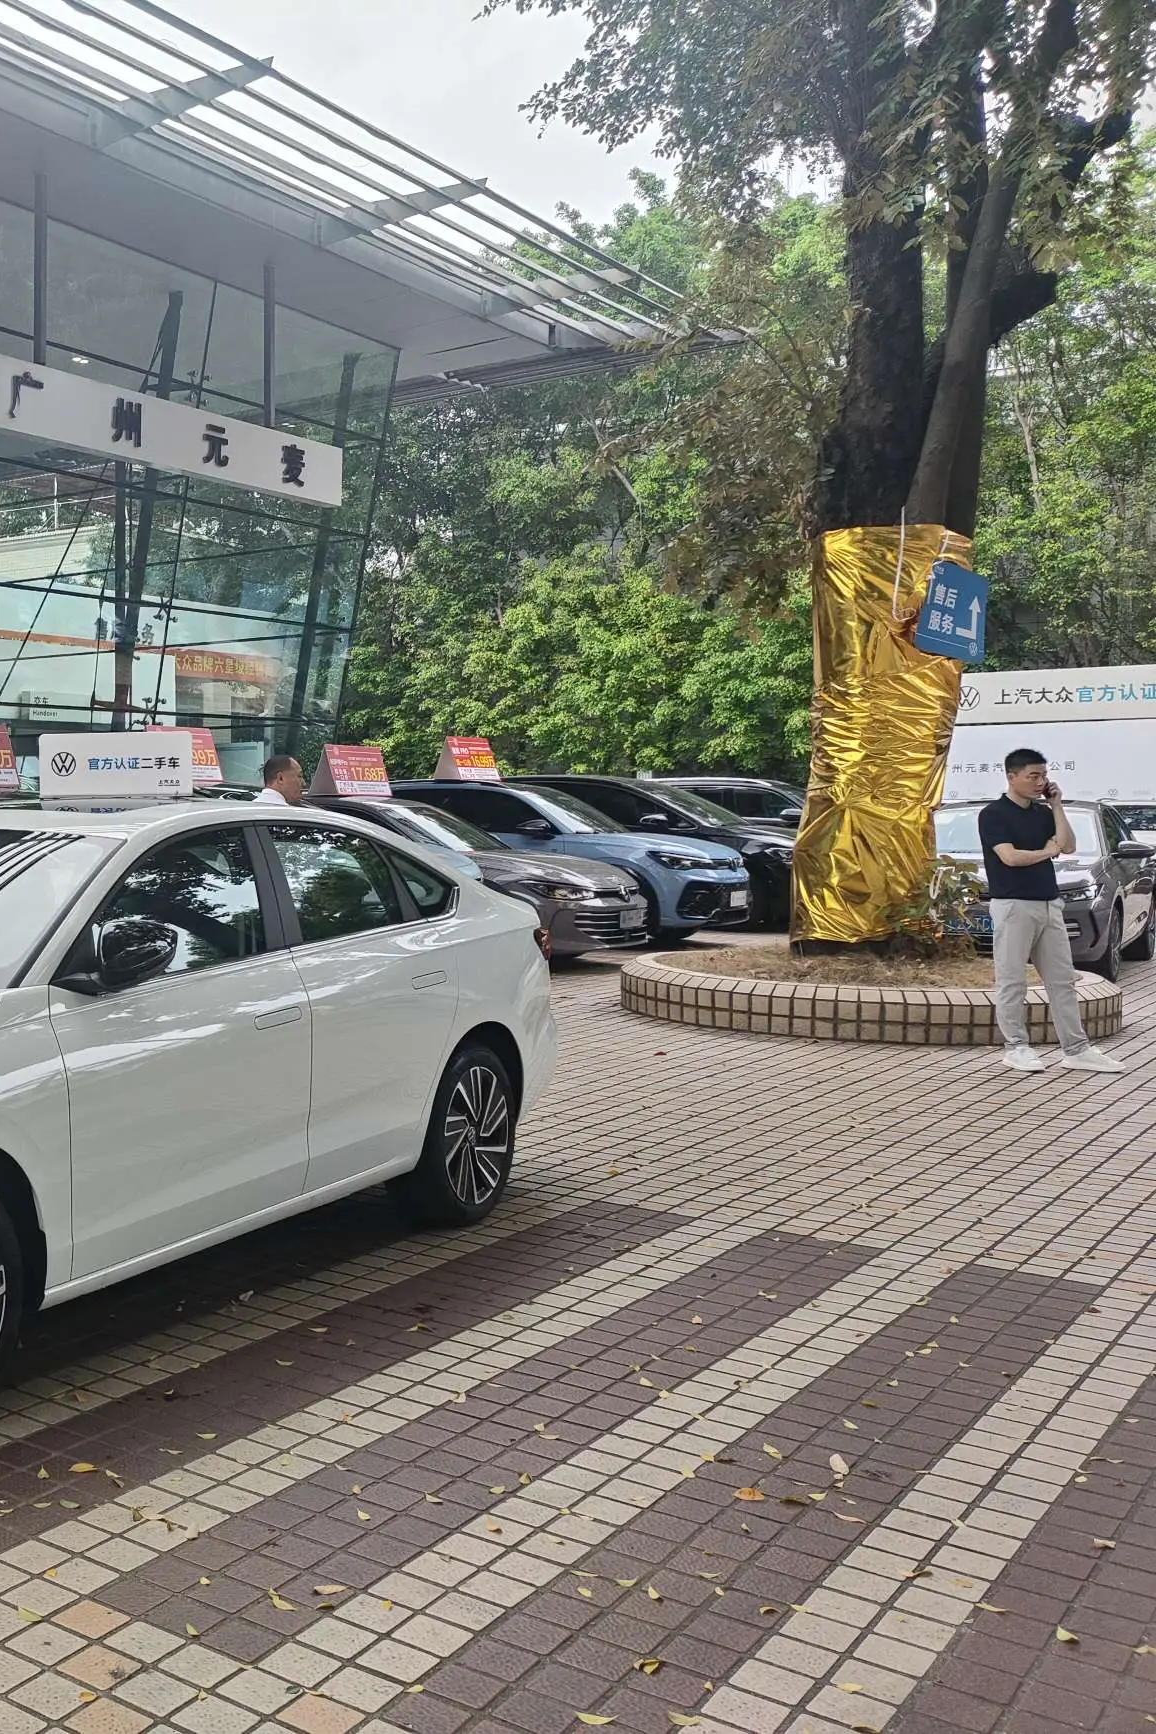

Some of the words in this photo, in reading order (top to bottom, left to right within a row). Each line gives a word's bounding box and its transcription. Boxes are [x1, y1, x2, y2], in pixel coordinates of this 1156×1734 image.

[8, 371, 308, 488] 广州元麦
[933, 583, 958, 609] 售后
[927, 609, 954, 635] 服务
[87, 756, 181, 771] 官方认证二手车
[350, 766, 386, 782] 17.68万
